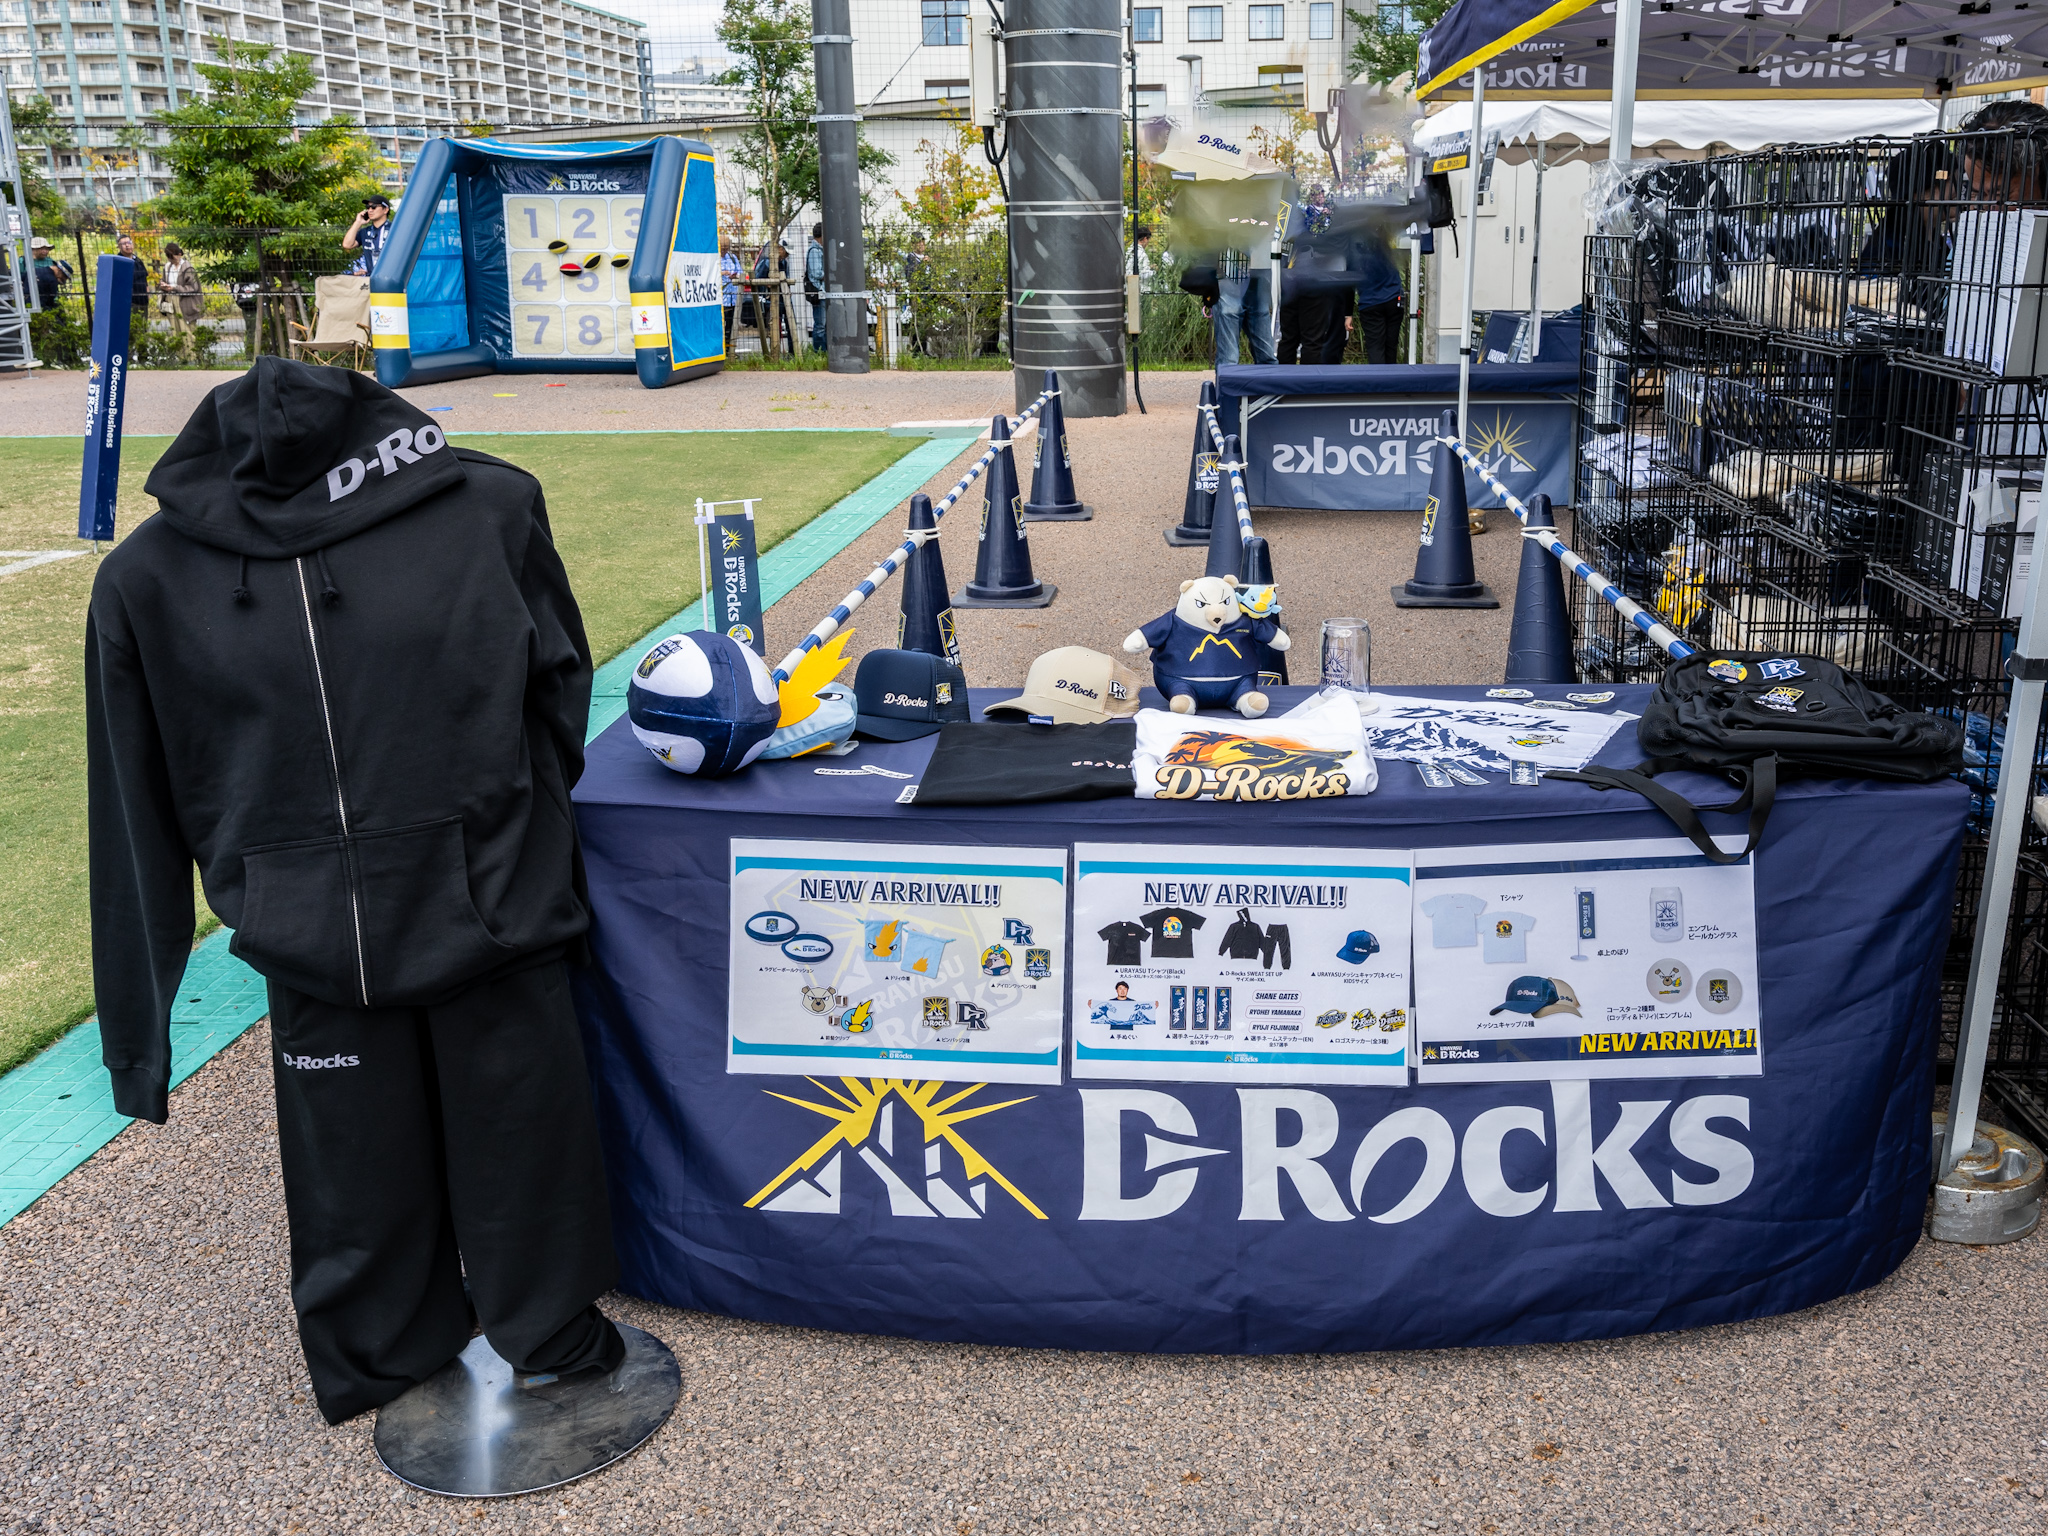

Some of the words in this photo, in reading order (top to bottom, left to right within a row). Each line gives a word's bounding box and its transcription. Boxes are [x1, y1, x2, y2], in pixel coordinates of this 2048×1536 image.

[1198, 134, 1241, 155] D-Rocks
[523, 208, 539, 239] 1
[572, 208, 597, 239] 2
[624, 208, 641, 239] 3
[522, 263, 547, 292] 4
[527, 315, 550, 345] 7
[578, 315, 602, 345] 8
[106, 408, 118, 448] Business
[738, 556, 747, 593] URAYASU
[883, 692, 928, 707] D-Rocks
[1055, 679, 1098, 699] D-Rocks
[1155, 764, 1350, 800] D-Rocks
[800, 878, 864, 901] NEW
[871, 881, 1000, 905] ARRIVAL!!
[1144, 882, 1210, 903] NEW
[1214, 884, 1346, 906] ARRIVAL!!
[1688, 932, 1738, 940] ビールカングラス
[1597, 948, 1629, 956] 卓上のぼり
[1607, 1005, 1655, 1013] コースター2種類
[1580, 1031, 1638, 1053] NEW
[1641, 1029, 1757, 1051] ARRIVAL!!
[282, 1052, 360, 1069] D-Rocks
